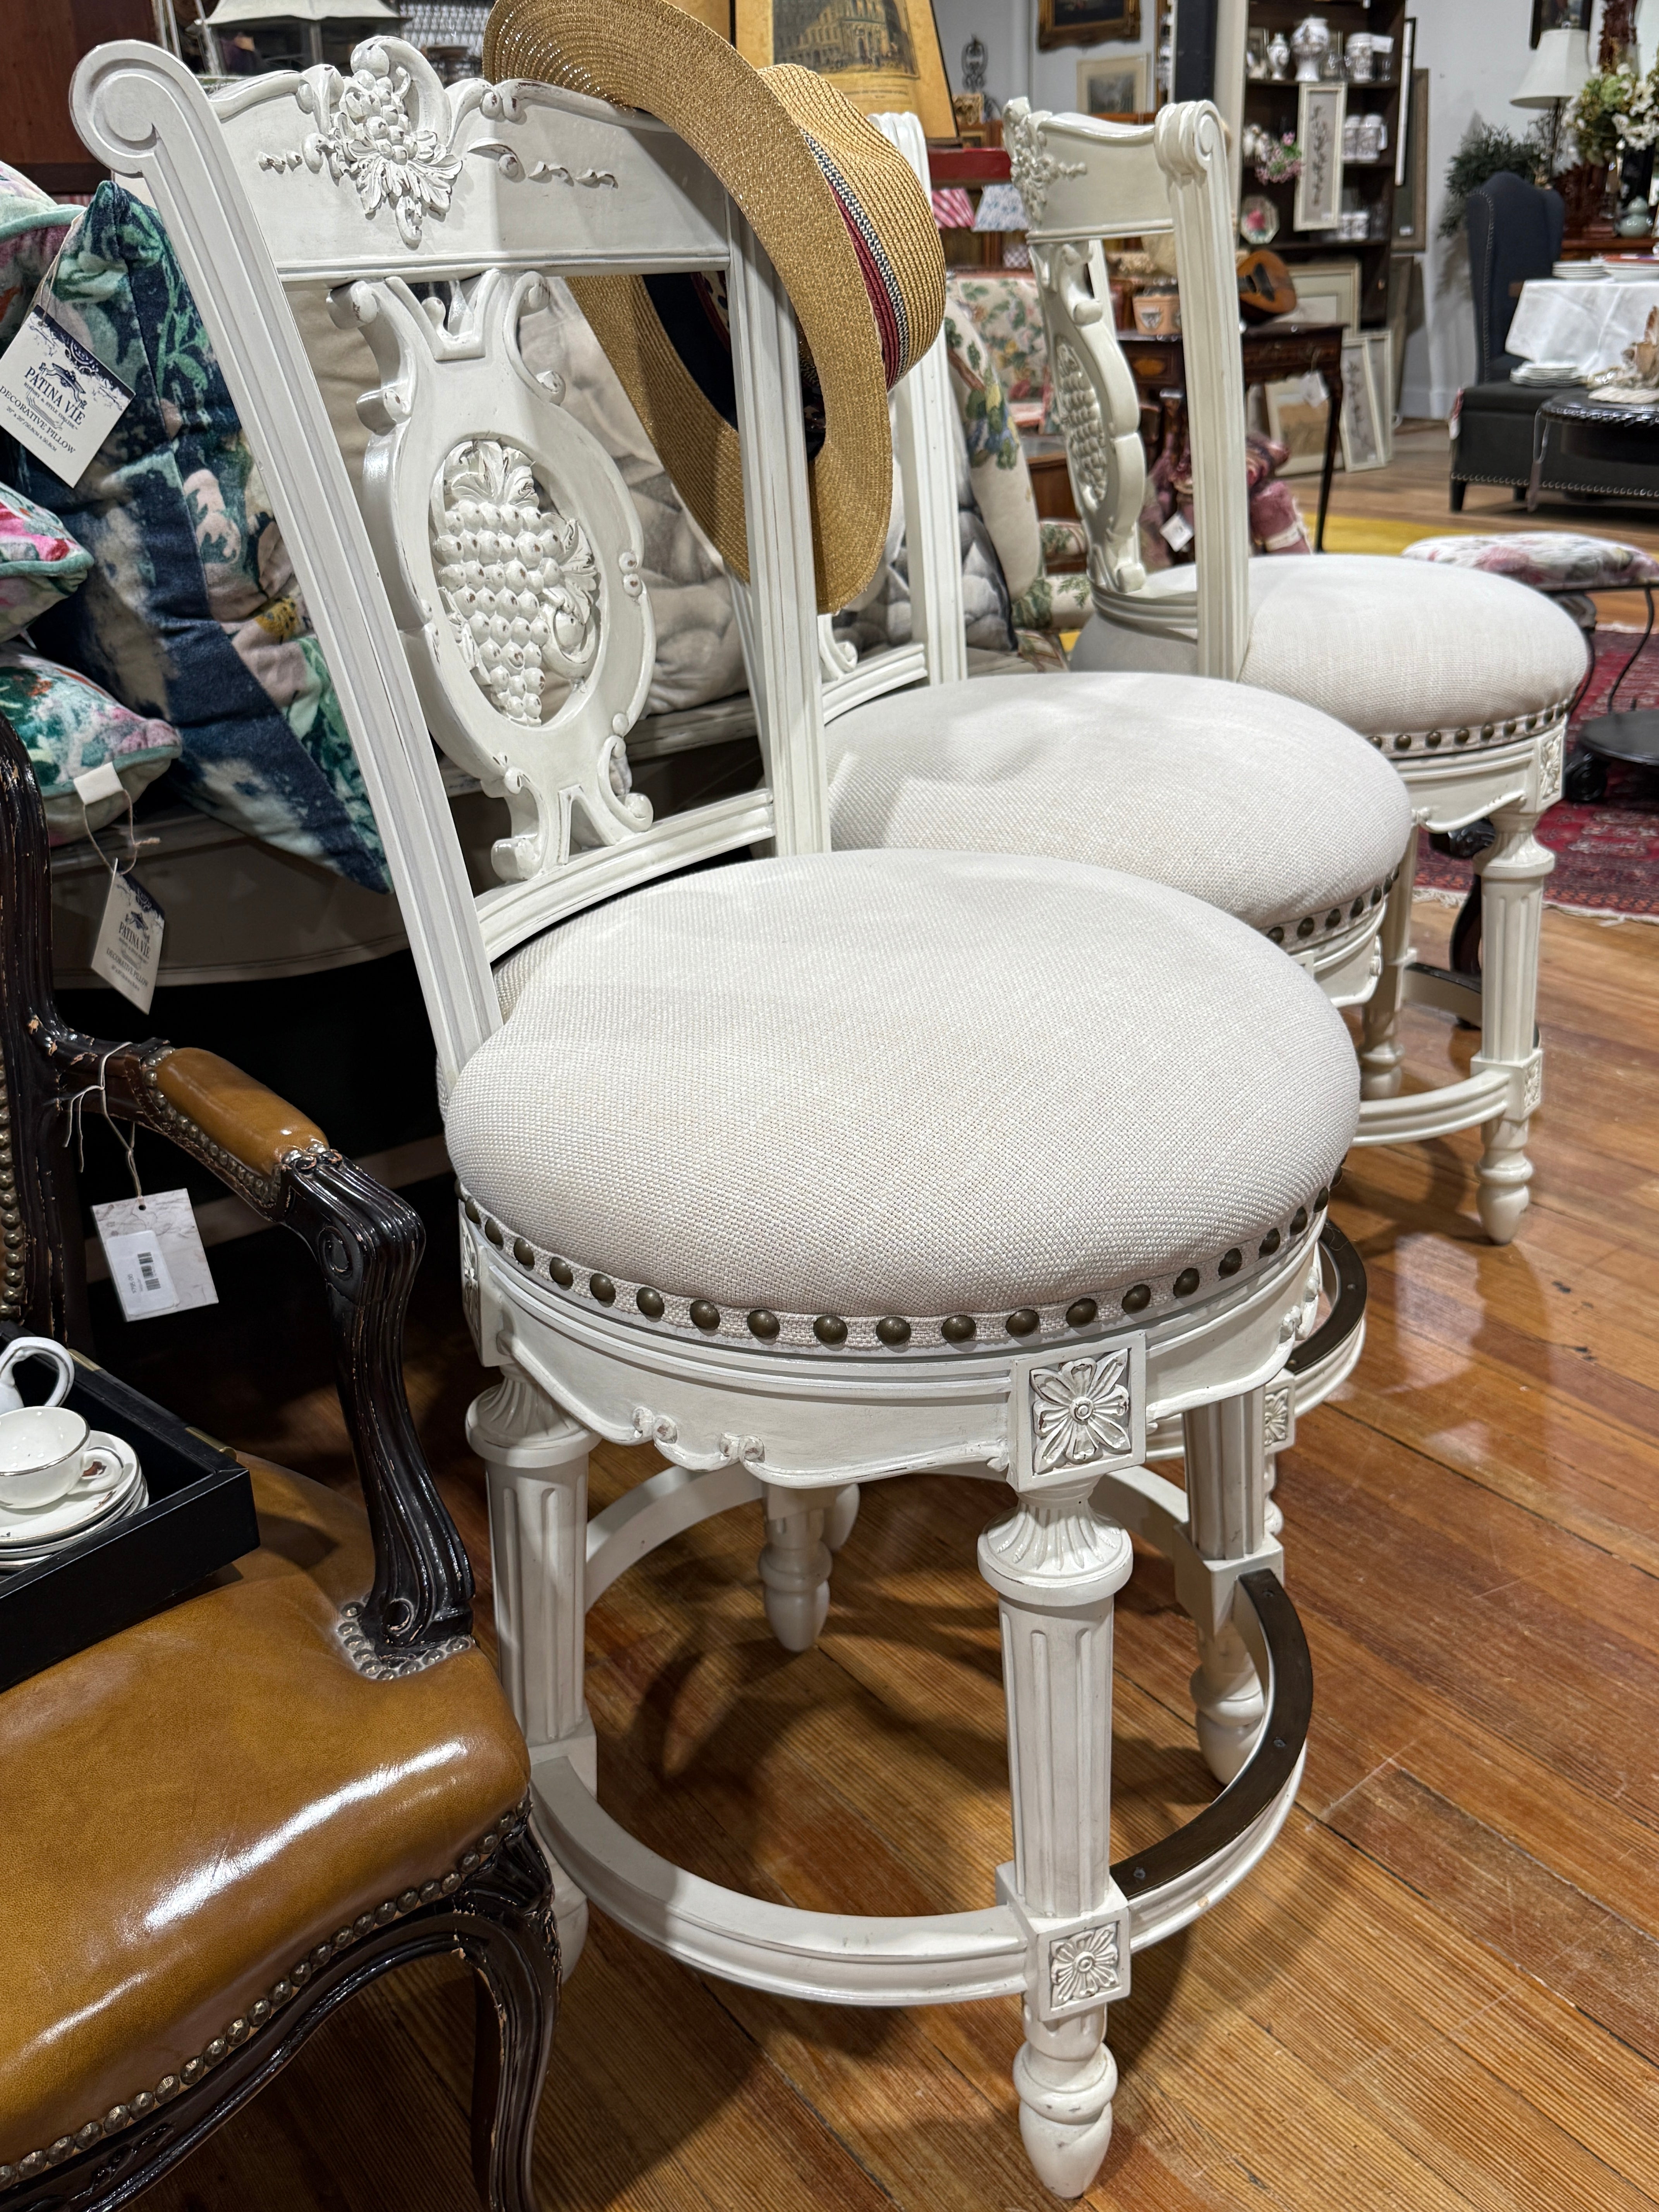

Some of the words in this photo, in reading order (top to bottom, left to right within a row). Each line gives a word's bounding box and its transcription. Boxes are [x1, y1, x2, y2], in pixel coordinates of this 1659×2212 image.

[0, 385, 48, 430] DECORATIVE
[46, 428, 76, 453] PILLOW
[24, 366, 63, 407] PATINA
[65, 400, 86, 426] VIE
[24, 382, 41, 398] HISTORY
[45, 401, 58, 414] STYLE
[119, 921, 139, 949] PATINA
